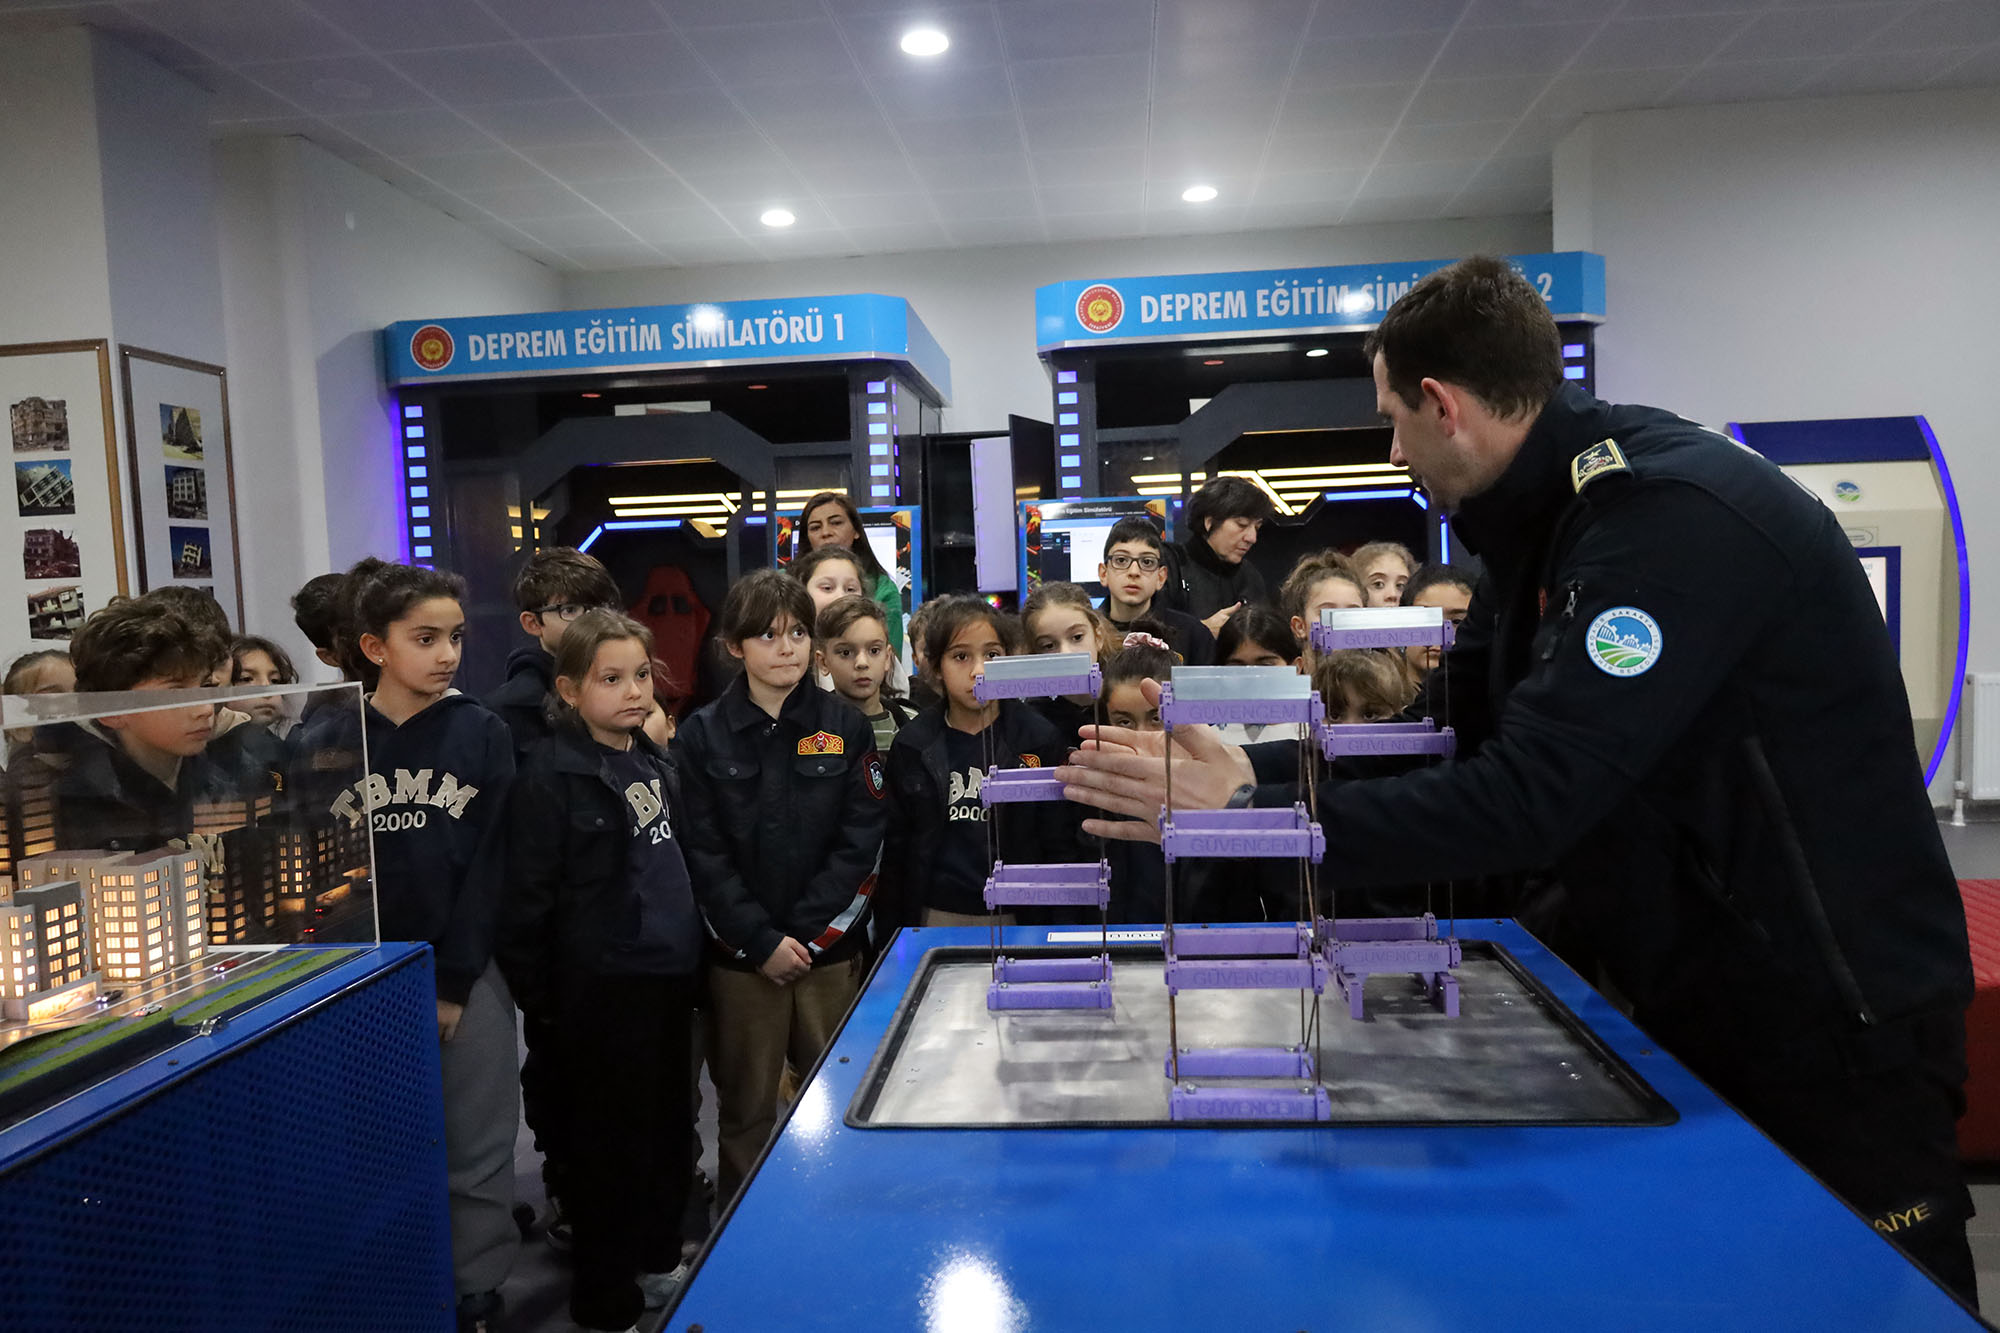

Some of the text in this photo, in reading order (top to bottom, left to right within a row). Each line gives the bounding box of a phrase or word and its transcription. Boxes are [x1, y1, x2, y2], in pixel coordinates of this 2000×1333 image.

[1140, 290, 1247, 324] DEPREM
[1256, 279, 1349, 318] EĞİTİM
[1537, 272, 1553, 302] 2
[468, 329, 568, 362] DEPREM
[574, 317, 662, 355] EĞİTİM
[833, 313, 845, 341] 1
[329, 768, 479, 829] TBMM
[373, 810, 427, 832] 2000
